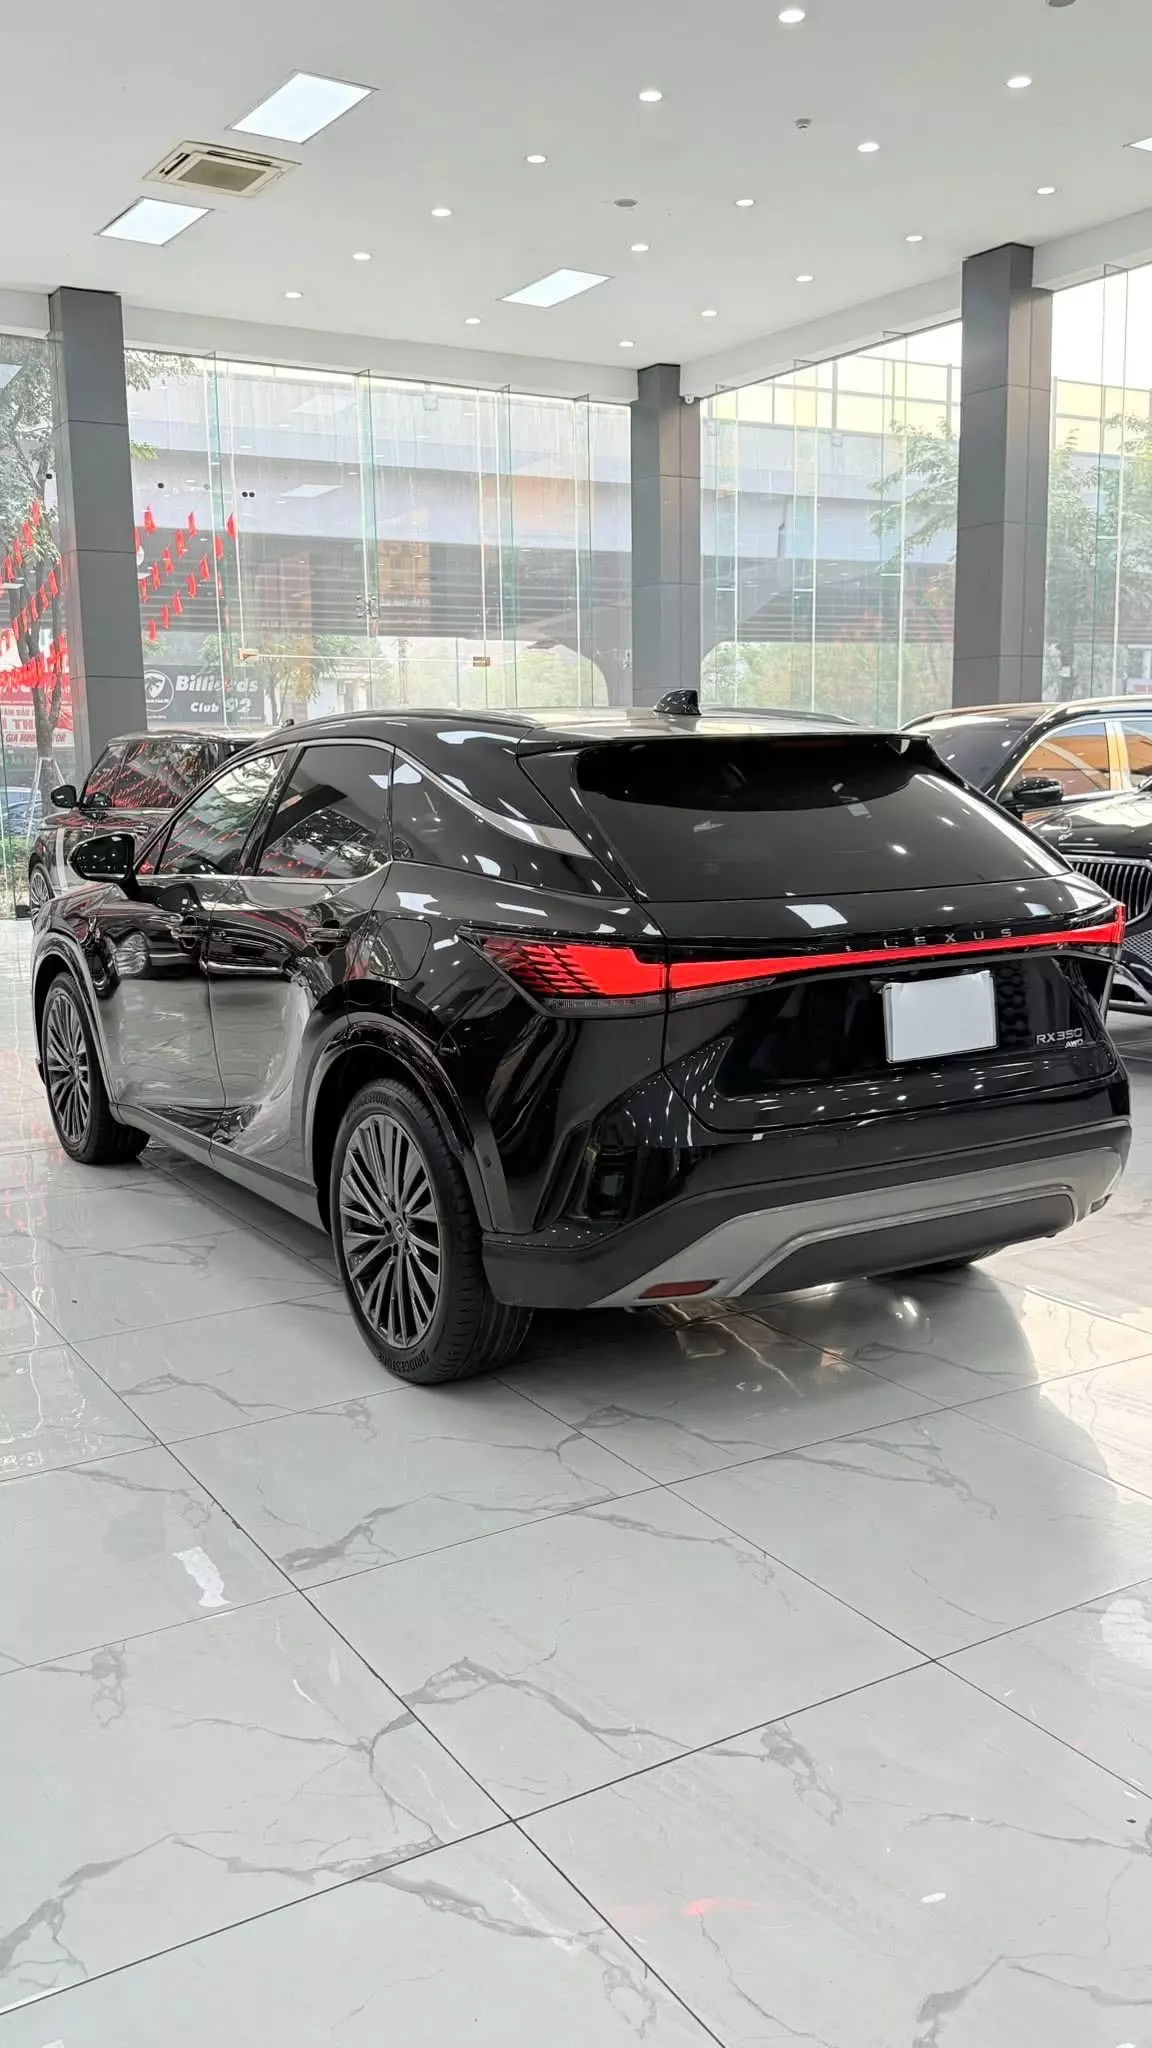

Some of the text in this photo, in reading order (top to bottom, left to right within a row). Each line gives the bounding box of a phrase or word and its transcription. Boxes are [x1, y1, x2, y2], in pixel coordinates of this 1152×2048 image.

[190, 702, 220, 713] Club
[883, 928, 1012, 949] LEXUS
[1036, 1027, 1083, 1045] RX350
[1064, 1038, 1084, 1049] AWD
